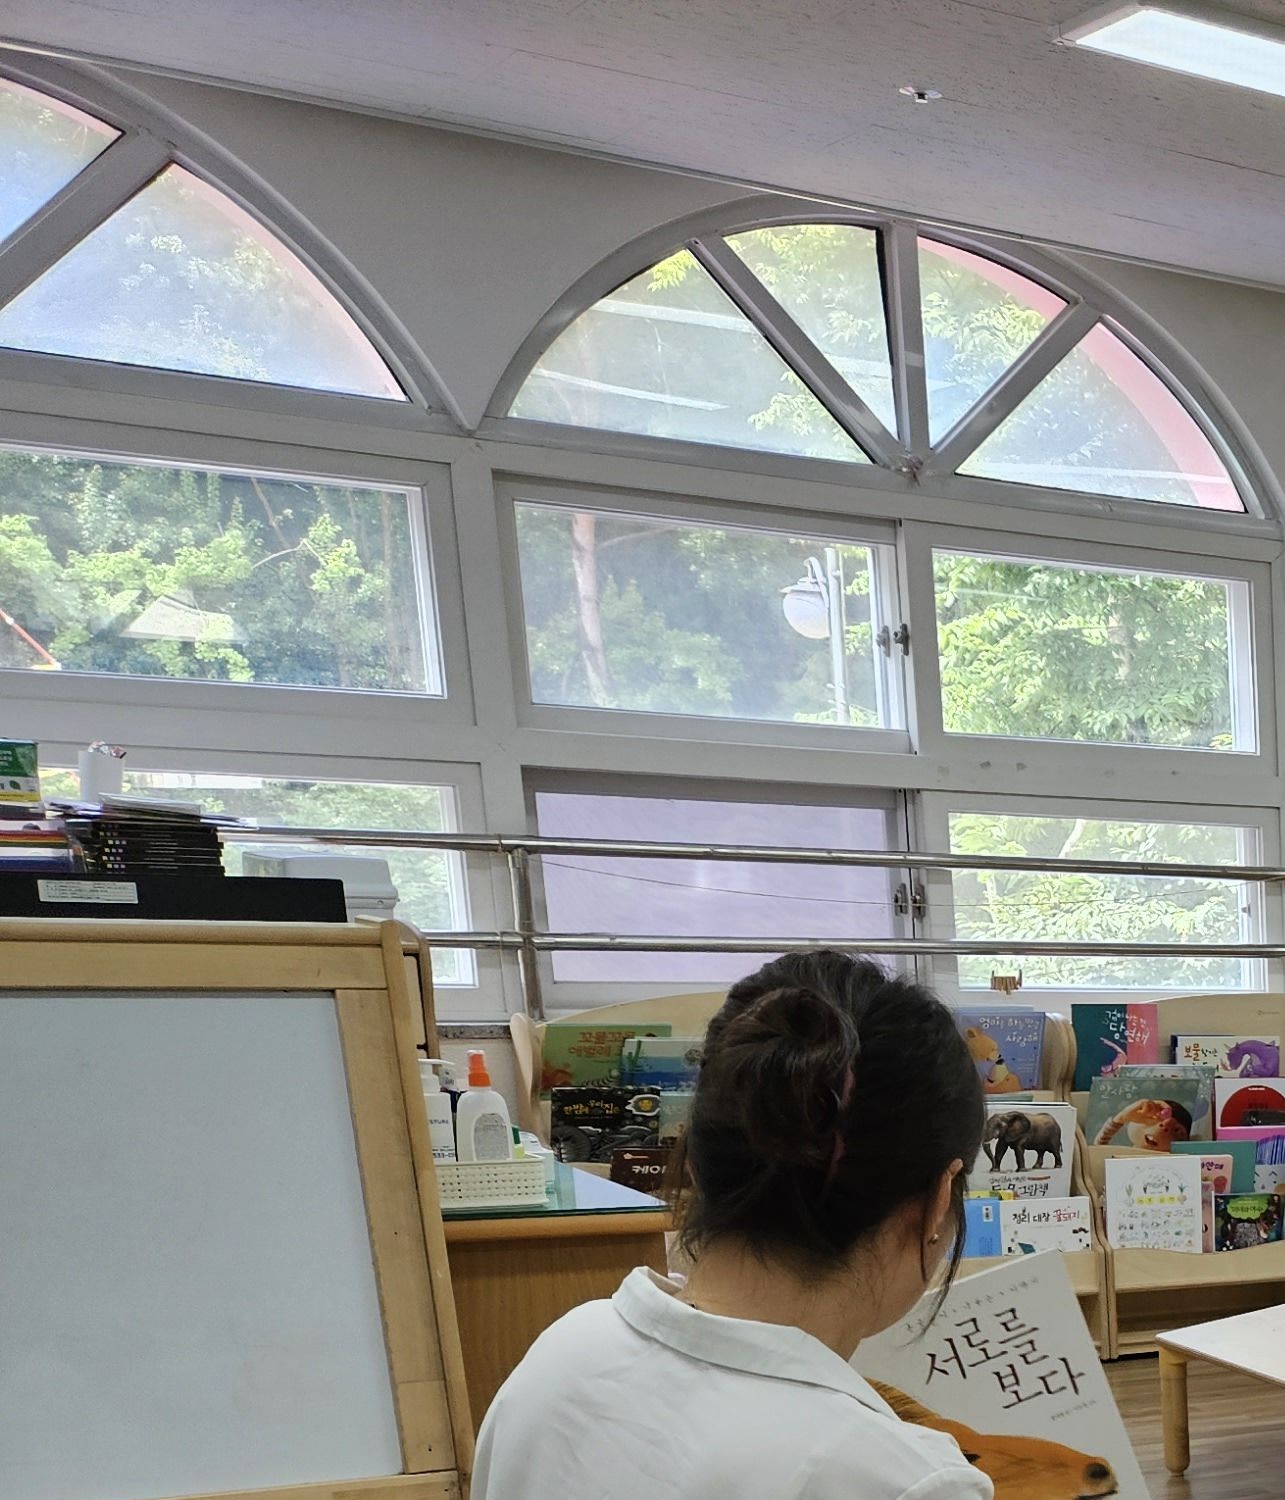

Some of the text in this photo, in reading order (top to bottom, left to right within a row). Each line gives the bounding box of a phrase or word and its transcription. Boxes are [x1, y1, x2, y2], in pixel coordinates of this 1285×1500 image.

[1184, 1042, 1201, 1062] 보물
[925, 1307, 1049, 1385] 서로를
[992, 1356, 1086, 1409] 보다
